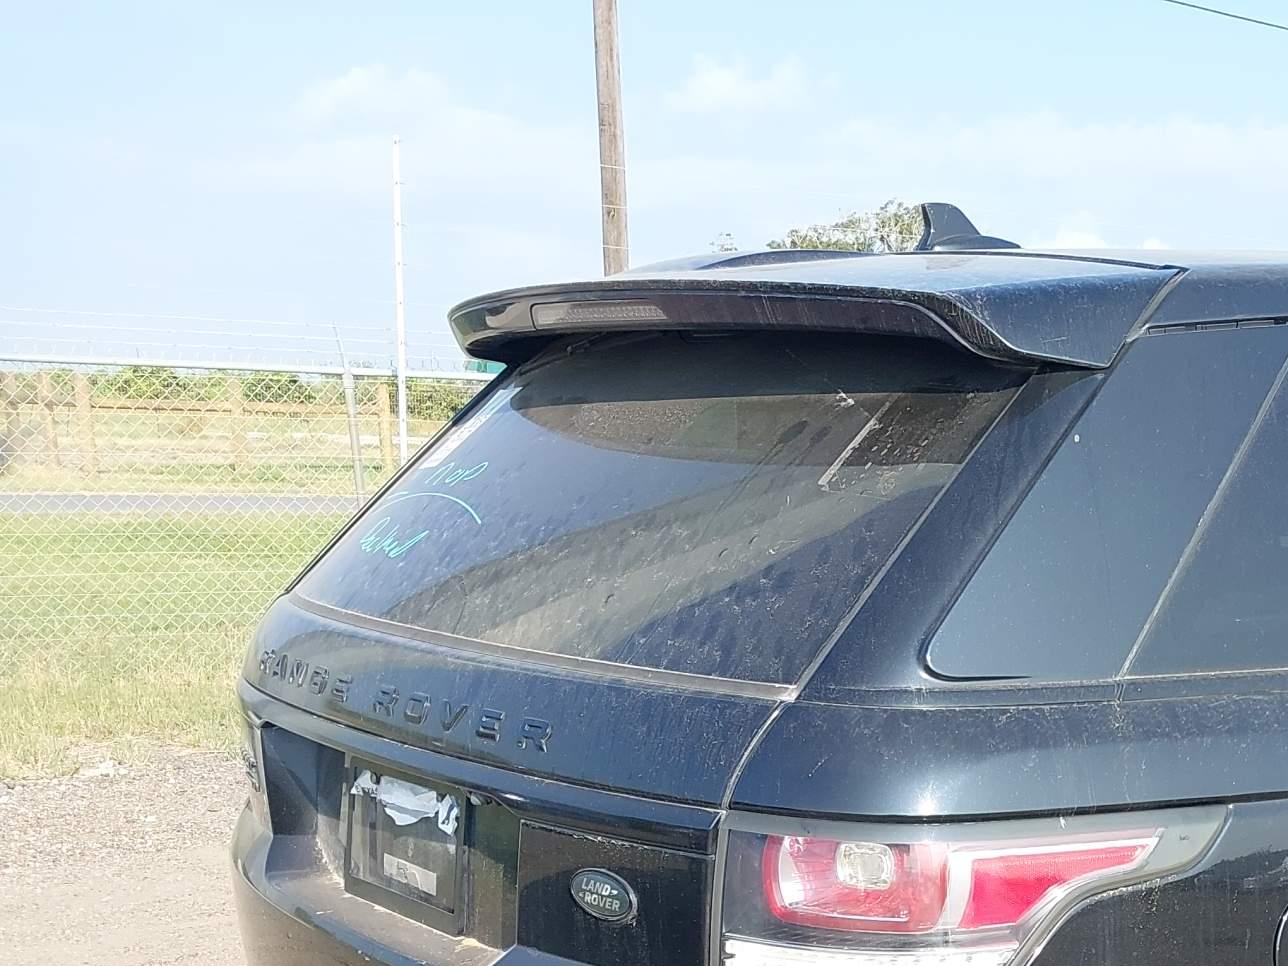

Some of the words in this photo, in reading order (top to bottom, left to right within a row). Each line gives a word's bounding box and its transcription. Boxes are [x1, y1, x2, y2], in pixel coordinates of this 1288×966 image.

[259, 649, 353, 704] RANGE
[373, 685, 554, 753] ROVER
[581, 877, 612, 896] LAND
[583, 891, 621, 912] ROVER
